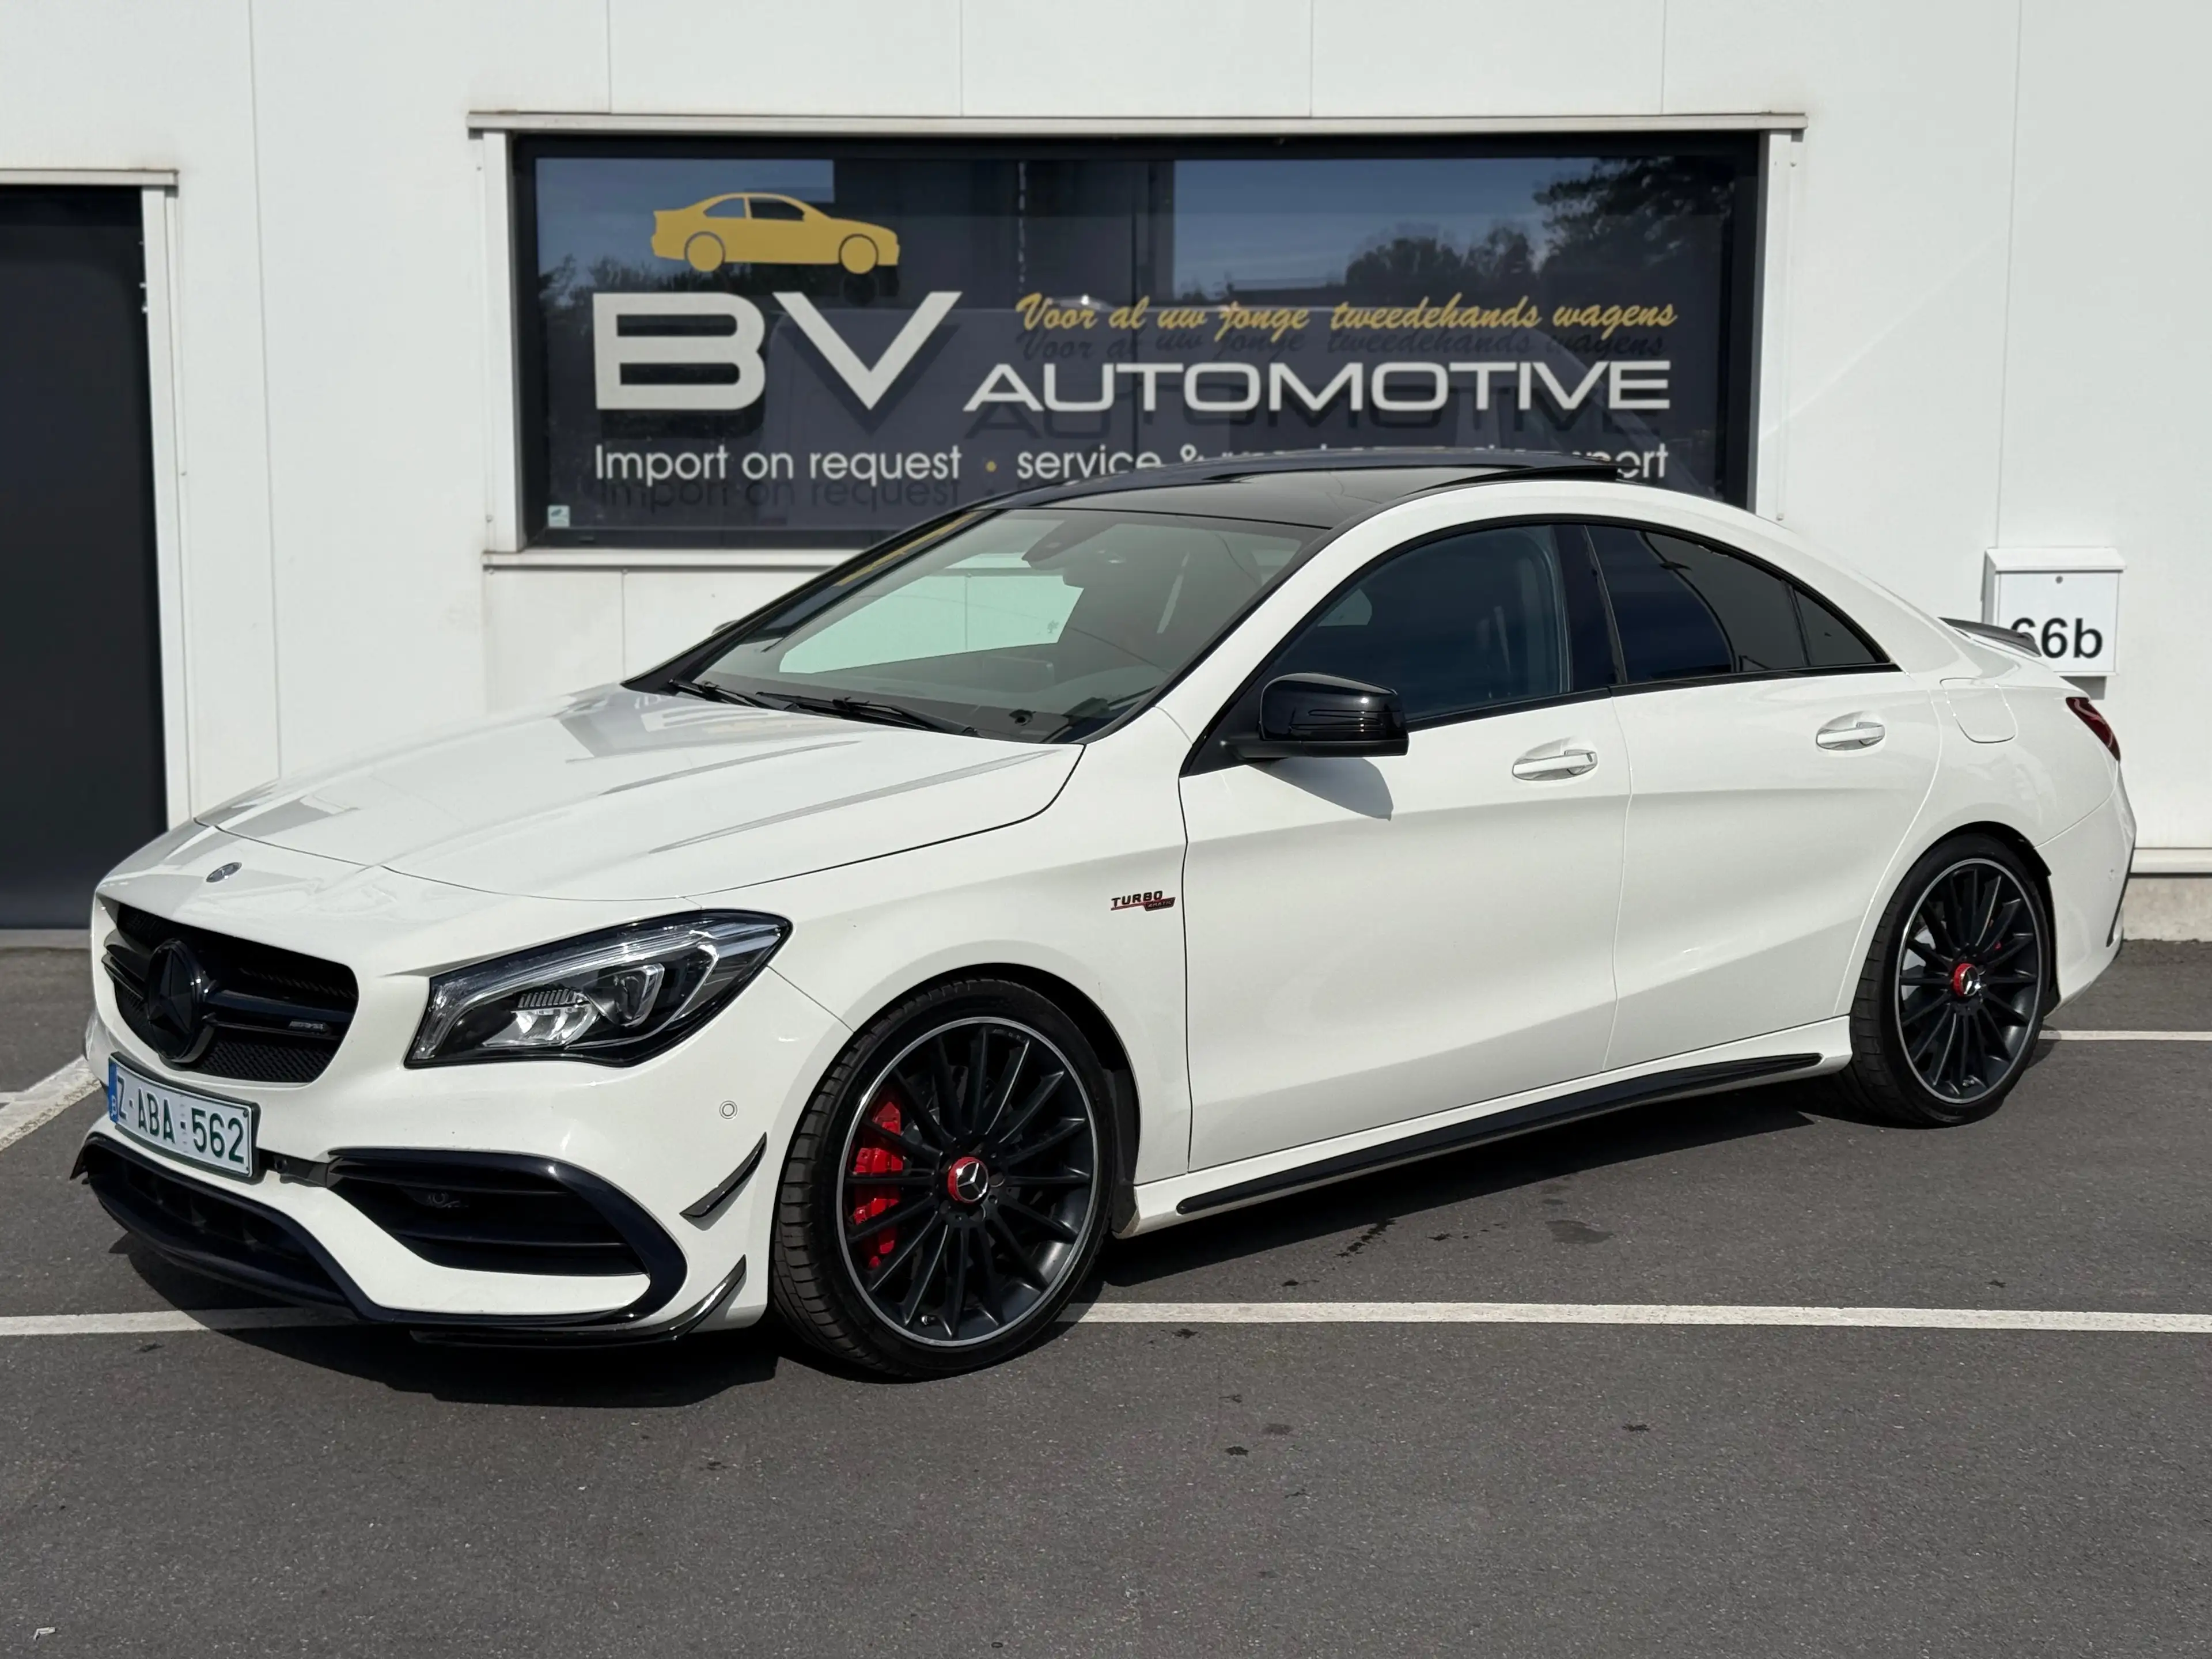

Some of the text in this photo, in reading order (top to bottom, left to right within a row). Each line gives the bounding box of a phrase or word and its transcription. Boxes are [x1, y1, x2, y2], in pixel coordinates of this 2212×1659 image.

[1015, 292, 1679, 342] Voor al uw jonge tweedehands wagens
[593, 291, 1670, 411] BV AUTOMOTIVE
[596, 445, 729, 486] Import
[741, 452, 794, 479] on
[809, 445, 962, 487] request
[1017, 444, 1162, 479] service
[1111, 890, 1163, 907] TURBO
